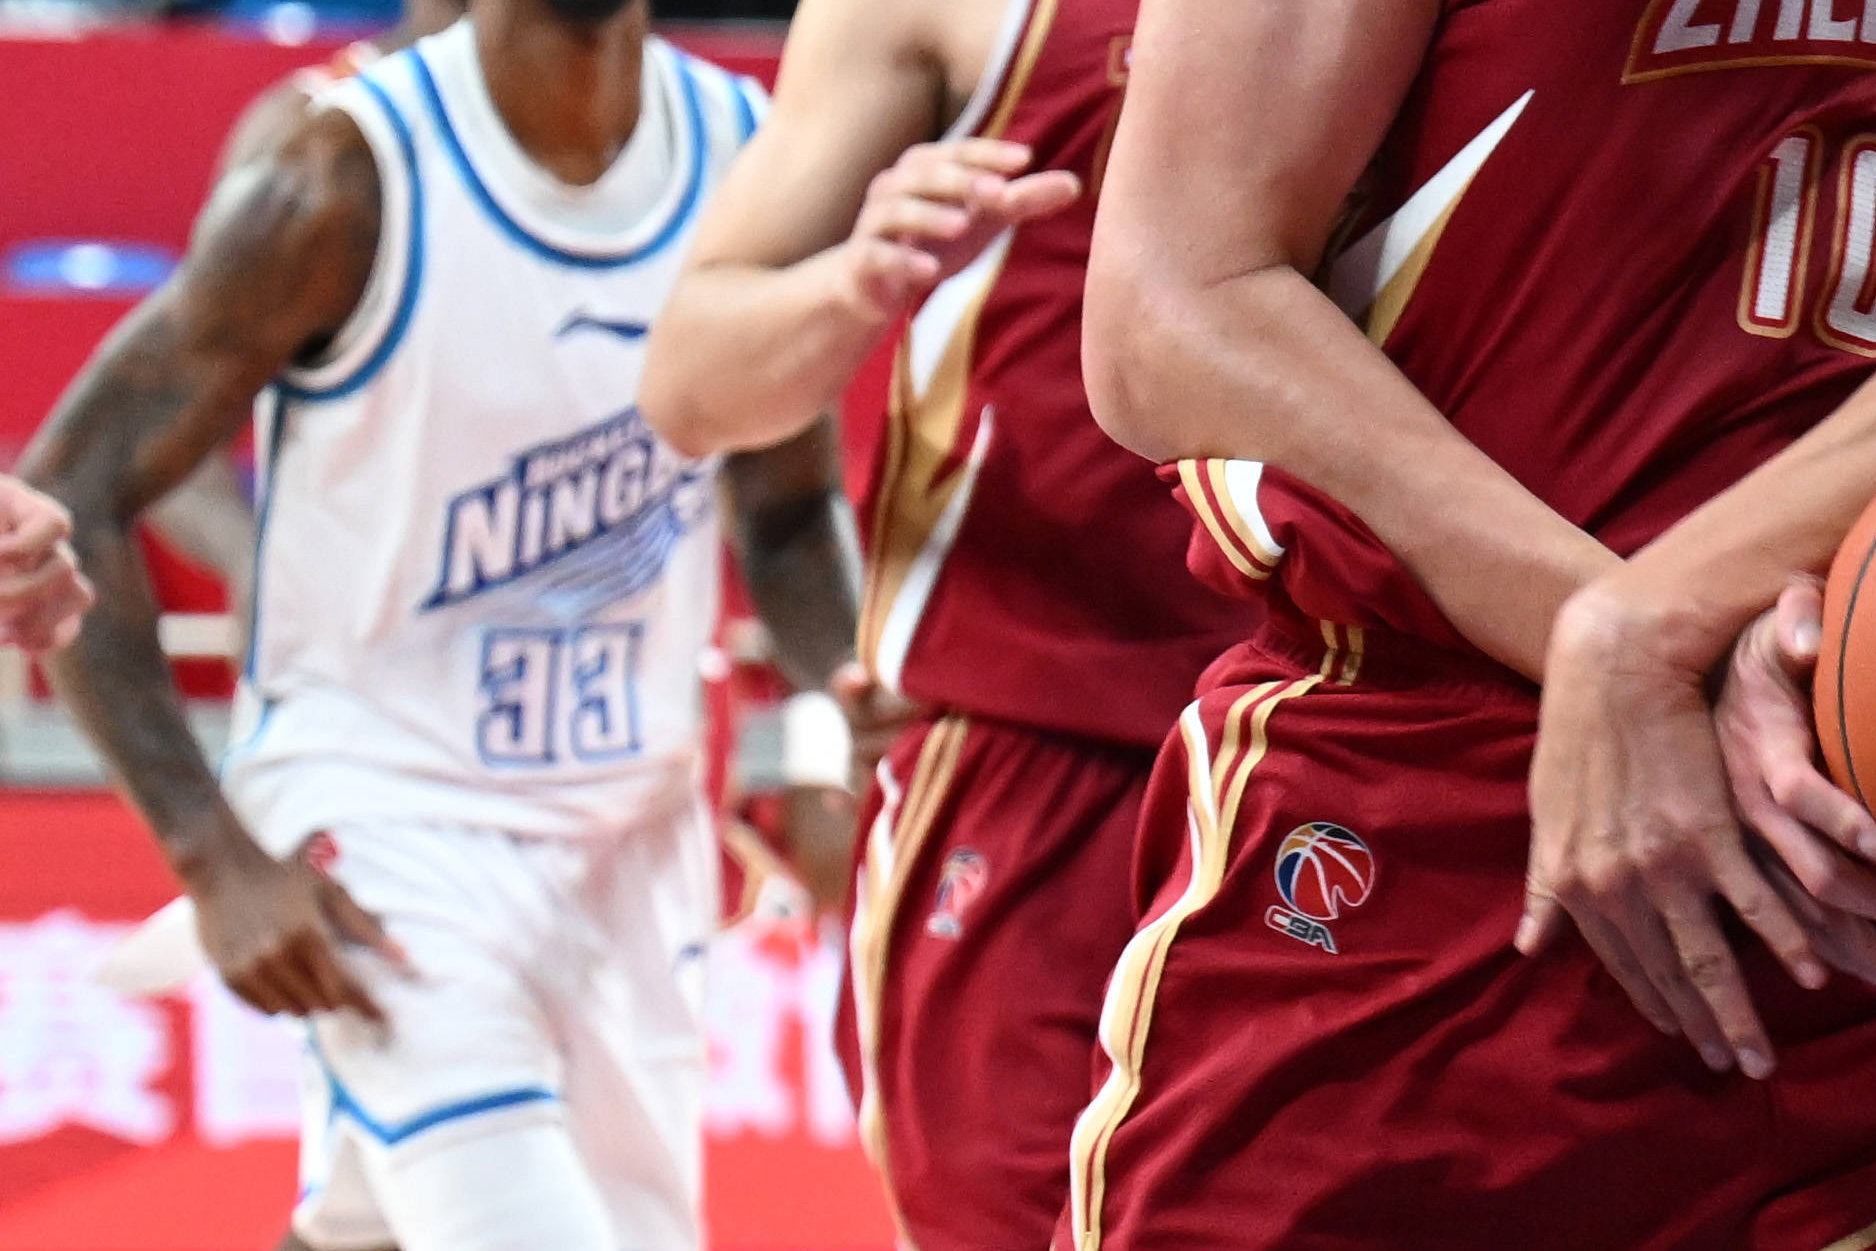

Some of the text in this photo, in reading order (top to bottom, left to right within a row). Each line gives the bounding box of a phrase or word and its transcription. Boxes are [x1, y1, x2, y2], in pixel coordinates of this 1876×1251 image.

[444, 438, 680, 595] NING
[478, 625, 643, 767] 33
[1264, 905, 1339, 954] CBA
